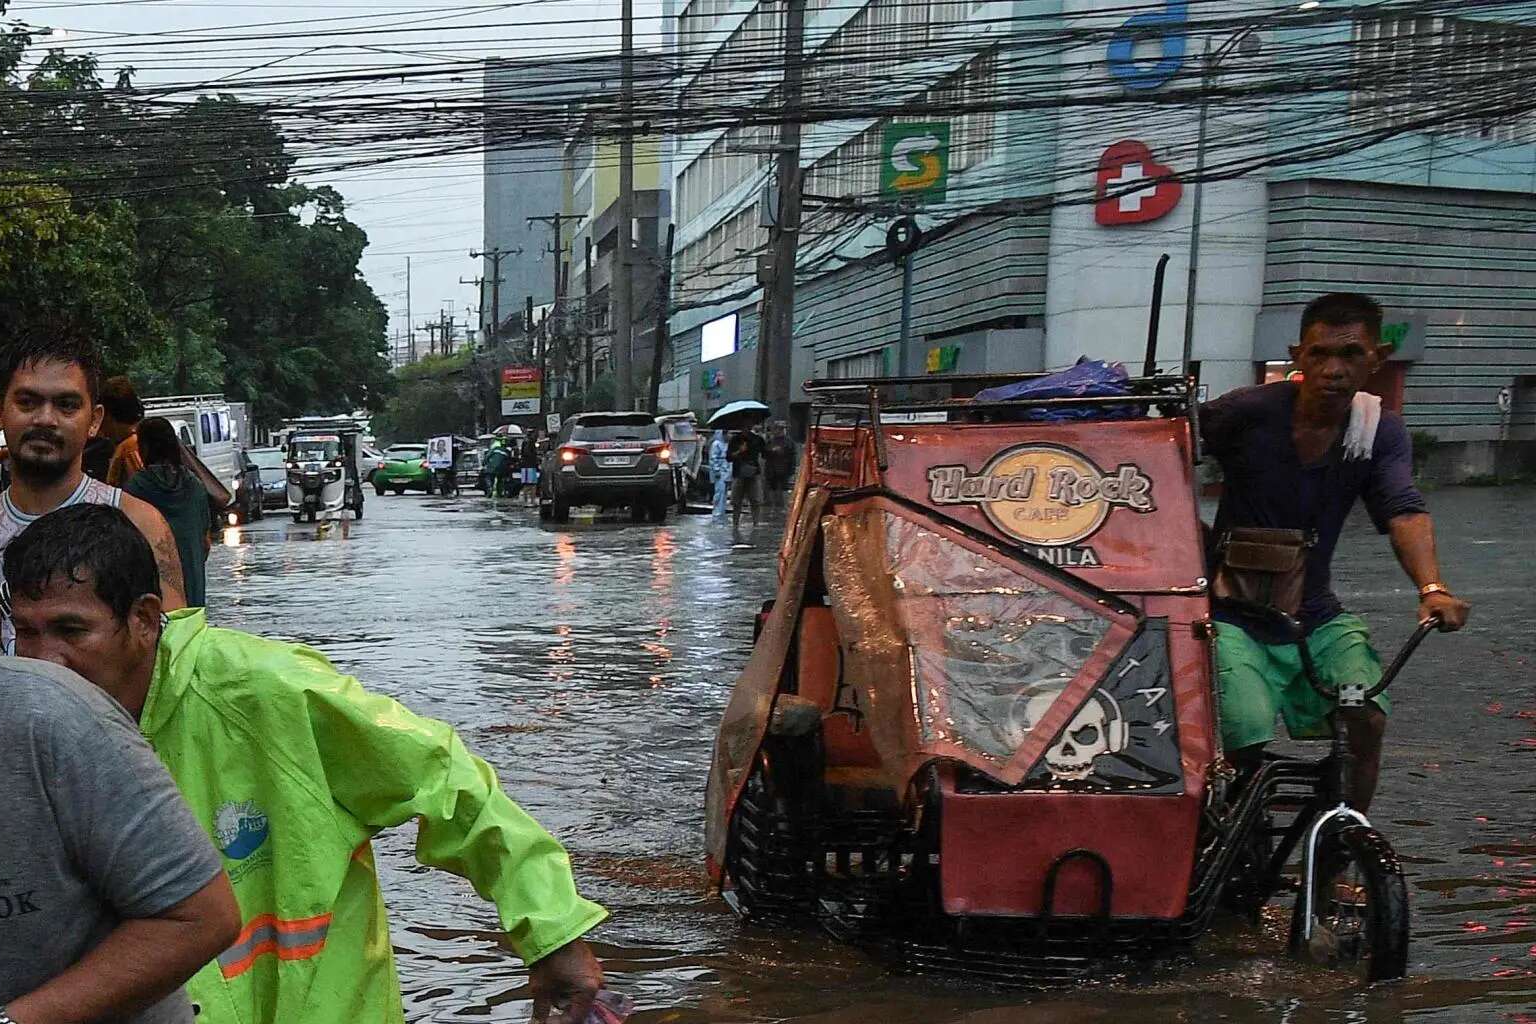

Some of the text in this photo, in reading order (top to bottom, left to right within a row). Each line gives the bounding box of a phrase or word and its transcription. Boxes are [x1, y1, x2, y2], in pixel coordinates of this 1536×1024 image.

[929, 464, 1155, 513] Hard Rock
[1014, 506, 1070, 522] CAFE
[1034, 547, 1098, 566] NILA
